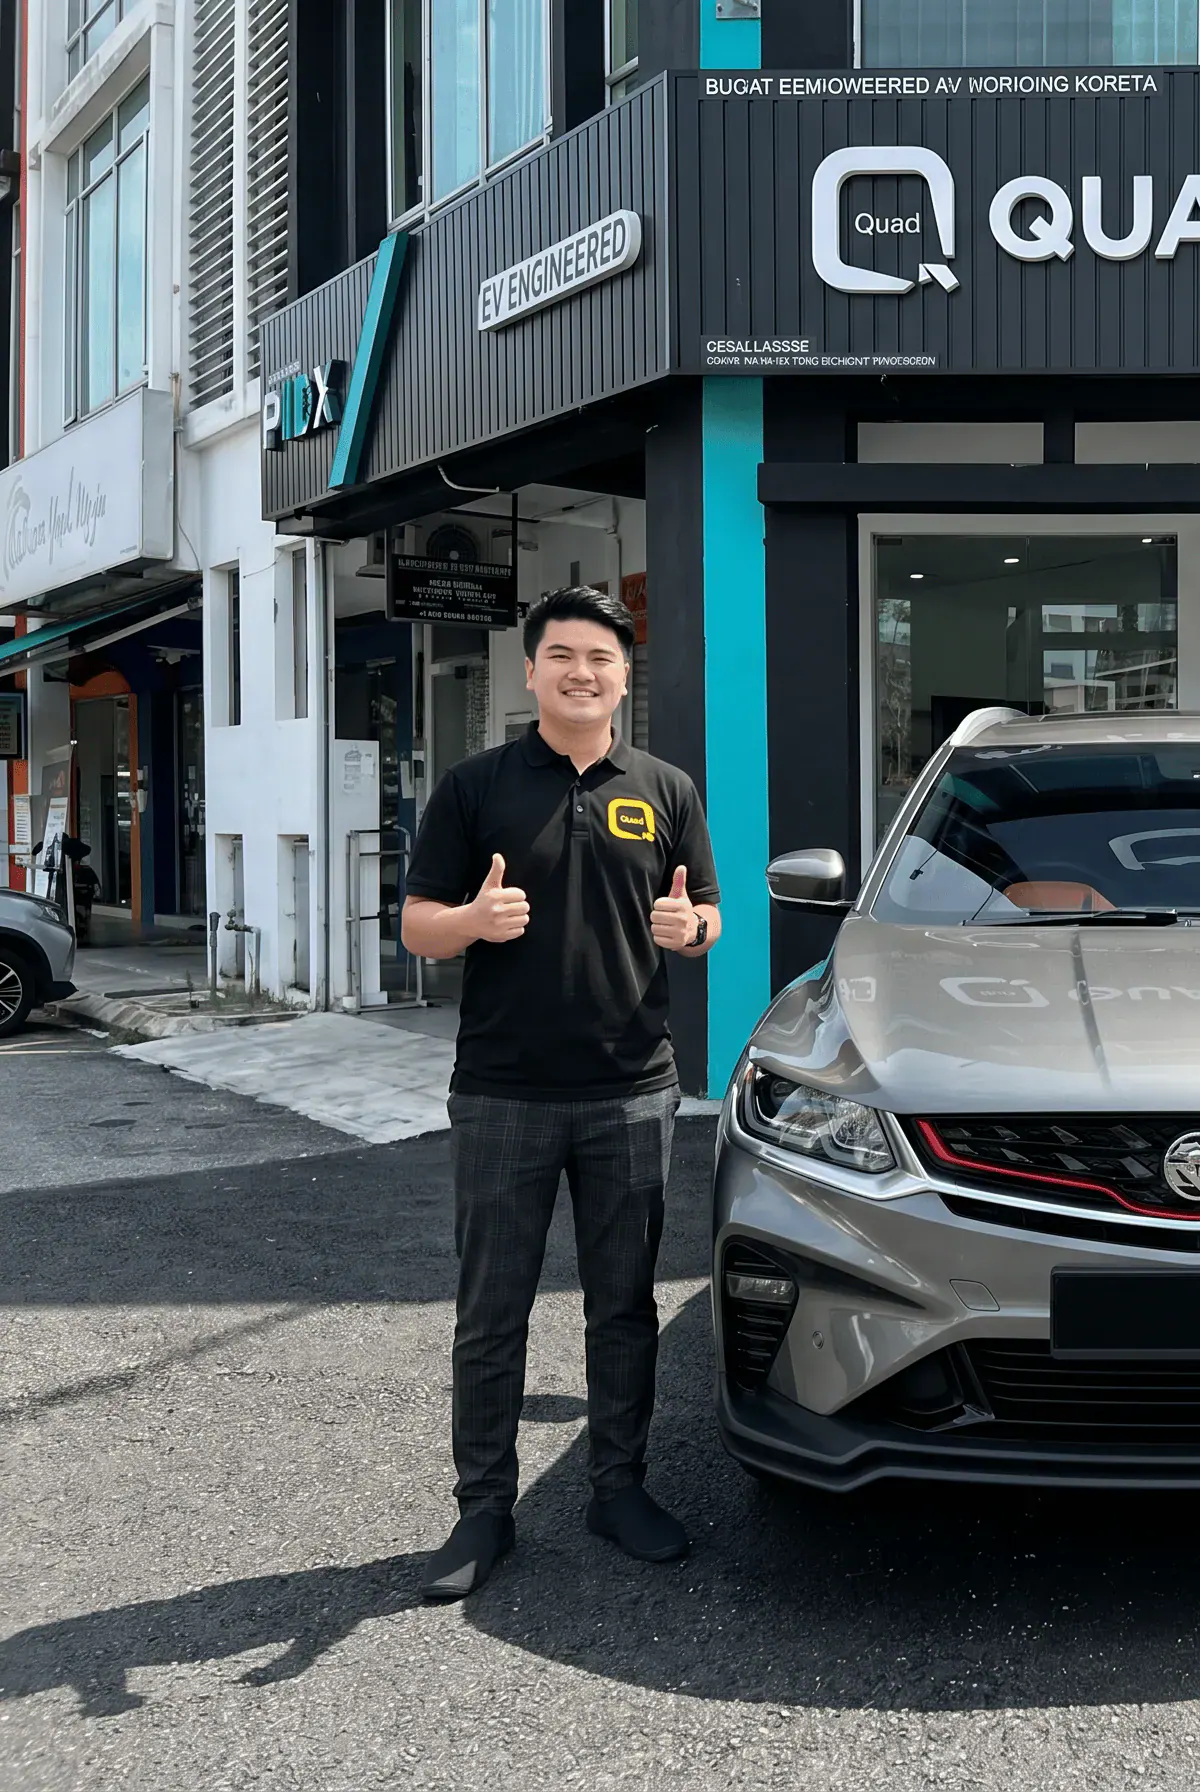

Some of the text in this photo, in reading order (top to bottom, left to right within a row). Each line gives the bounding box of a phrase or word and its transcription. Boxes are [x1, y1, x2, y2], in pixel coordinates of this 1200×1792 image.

[1075, 75, 1158, 92] KORETA
[854, 212, 921, 237] Quad
[482, 217, 626, 323] EV ENGINEERED
[792, 356, 819, 366] TONG
